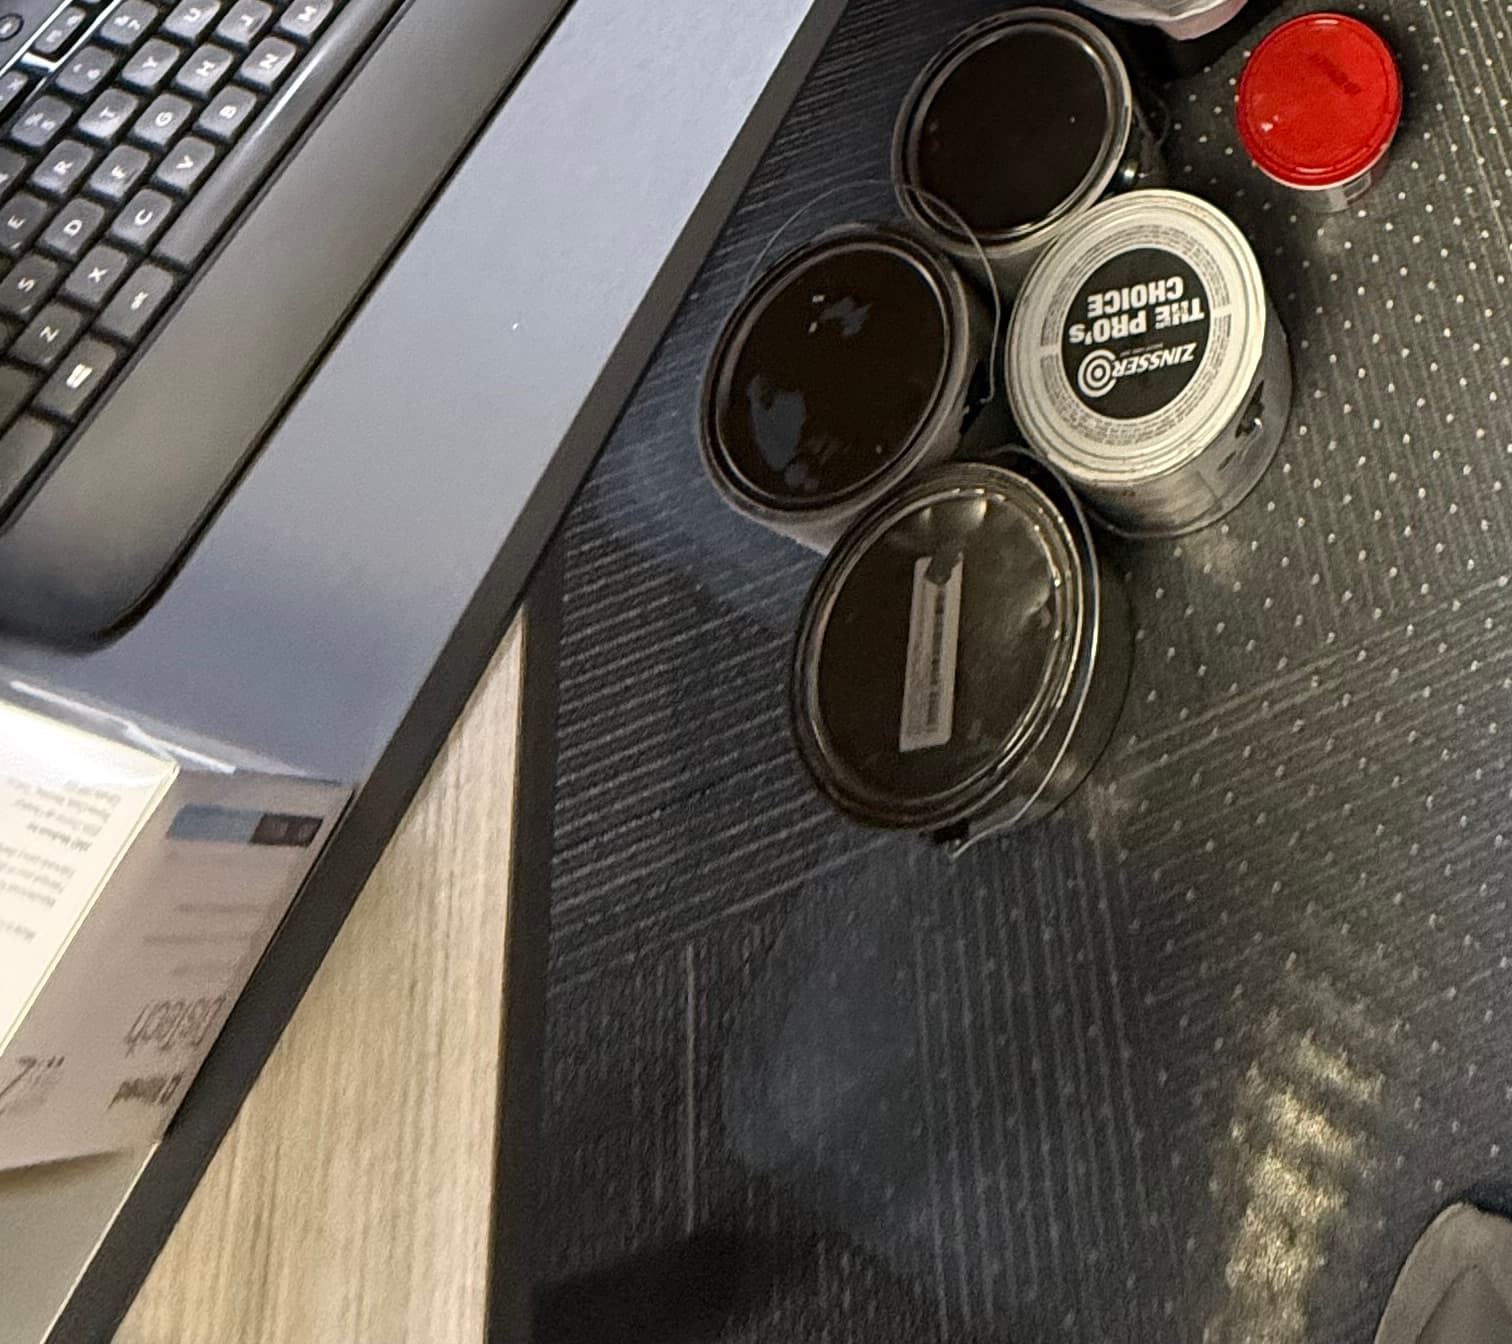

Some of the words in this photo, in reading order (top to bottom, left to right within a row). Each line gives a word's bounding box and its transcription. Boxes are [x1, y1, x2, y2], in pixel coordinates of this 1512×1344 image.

[196, 61, 215, 76] H
[155, 111, 173, 127] G
[54, 160, 72, 175] R
[176, 155, 194, 169] V
[8, 215, 25, 229] E
[135, 209, 153, 226] C
[64, 219, 83, 236] D
[90, 267, 107, 282] X
[18, 277, 35, 292] S
[1087, 276, 1184, 318] CHOICE
[1155, 297, 1205, 330] THE
[40, 326, 60, 341] Z
[1112, 342, 1197, 378] ZINSSER
